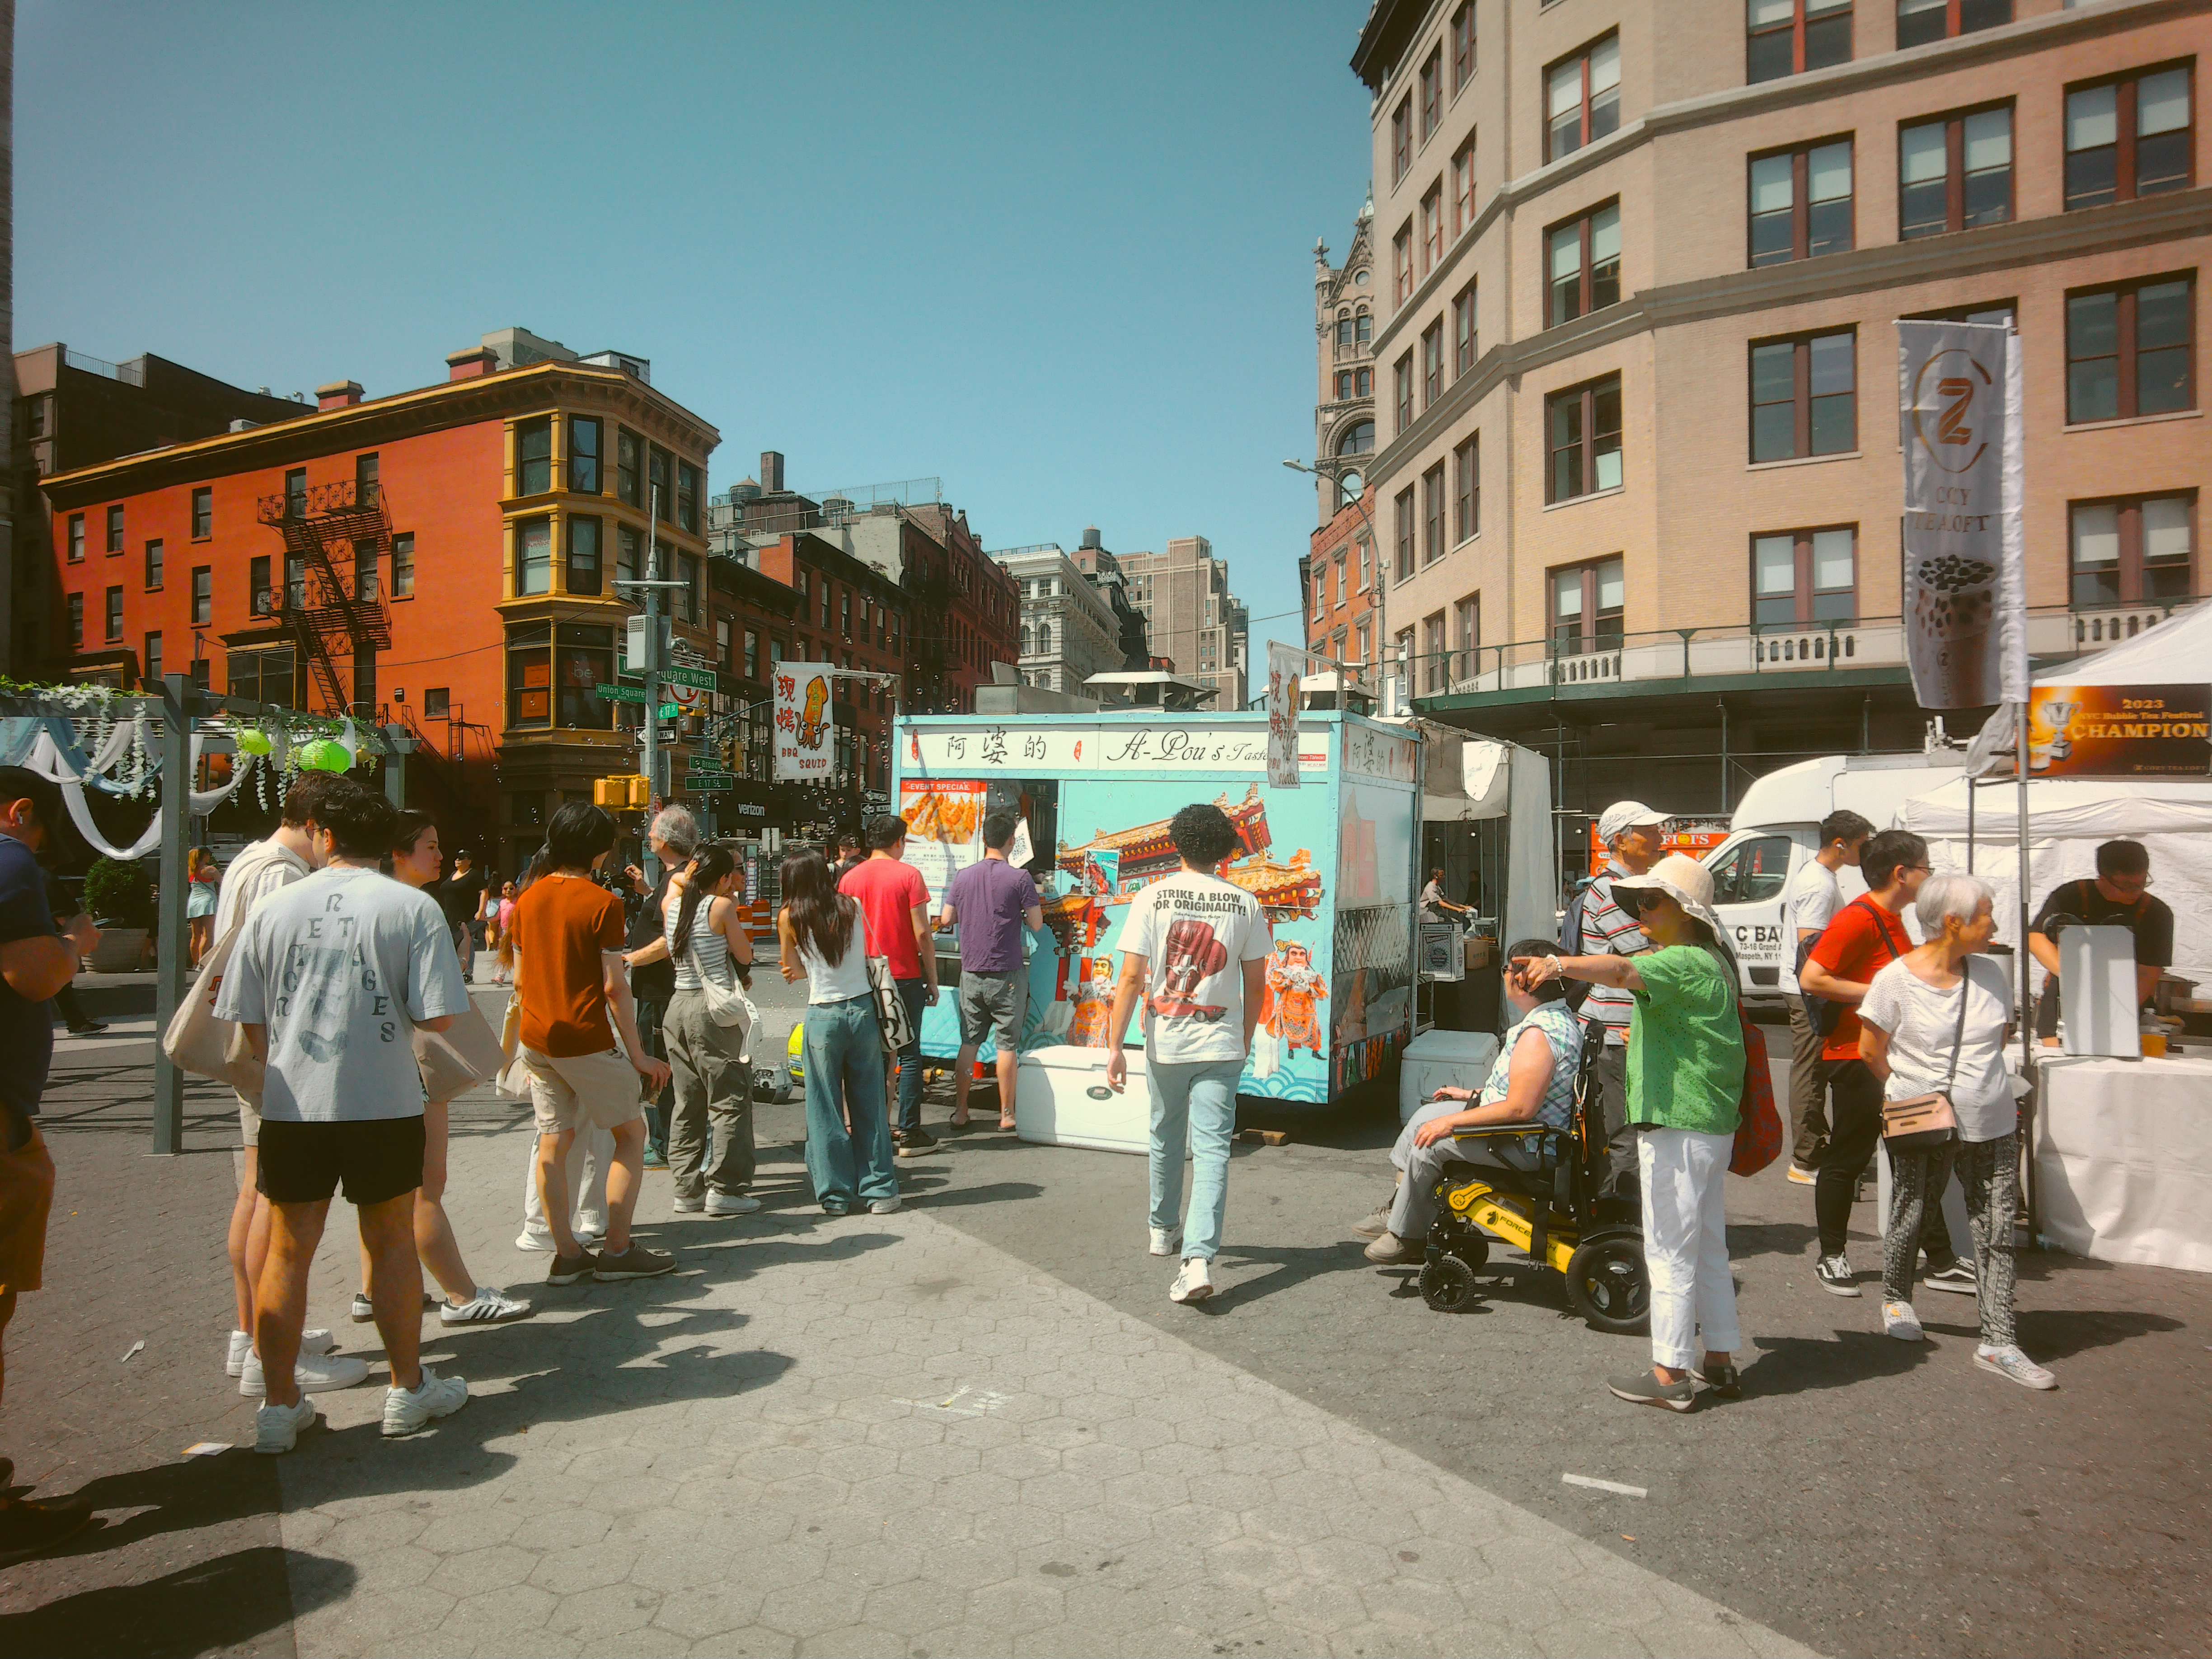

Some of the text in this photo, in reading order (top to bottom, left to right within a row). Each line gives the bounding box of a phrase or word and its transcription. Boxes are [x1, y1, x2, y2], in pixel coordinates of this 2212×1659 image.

[659, 670, 712, 686] quare West
[598, 684, 645, 698] Union Square
[2123, 699, 2165, 709] 2023
[2103, 712, 2138, 720] Bubble
[2161, 711, 2205, 719] Festival
[2071, 723, 2210, 740] CHAMPION
[947, 726, 1046, 764] 阿婆的
[782, 748, 798, 757] BBQ
[799, 759, 827, 769] SQUID
[698, 779, 702, 787] E
[705, 779, 710, 787] 17
[738, 801, 765, 816] verizon
[1157, 889, 1241, 904] STRIKE A BLOW
[1153, 899, 1246, 916] OR ORIGINALITY!
[1755, 926, 1783, 942] BA
[1758, 942, 1776, 951] Grand
